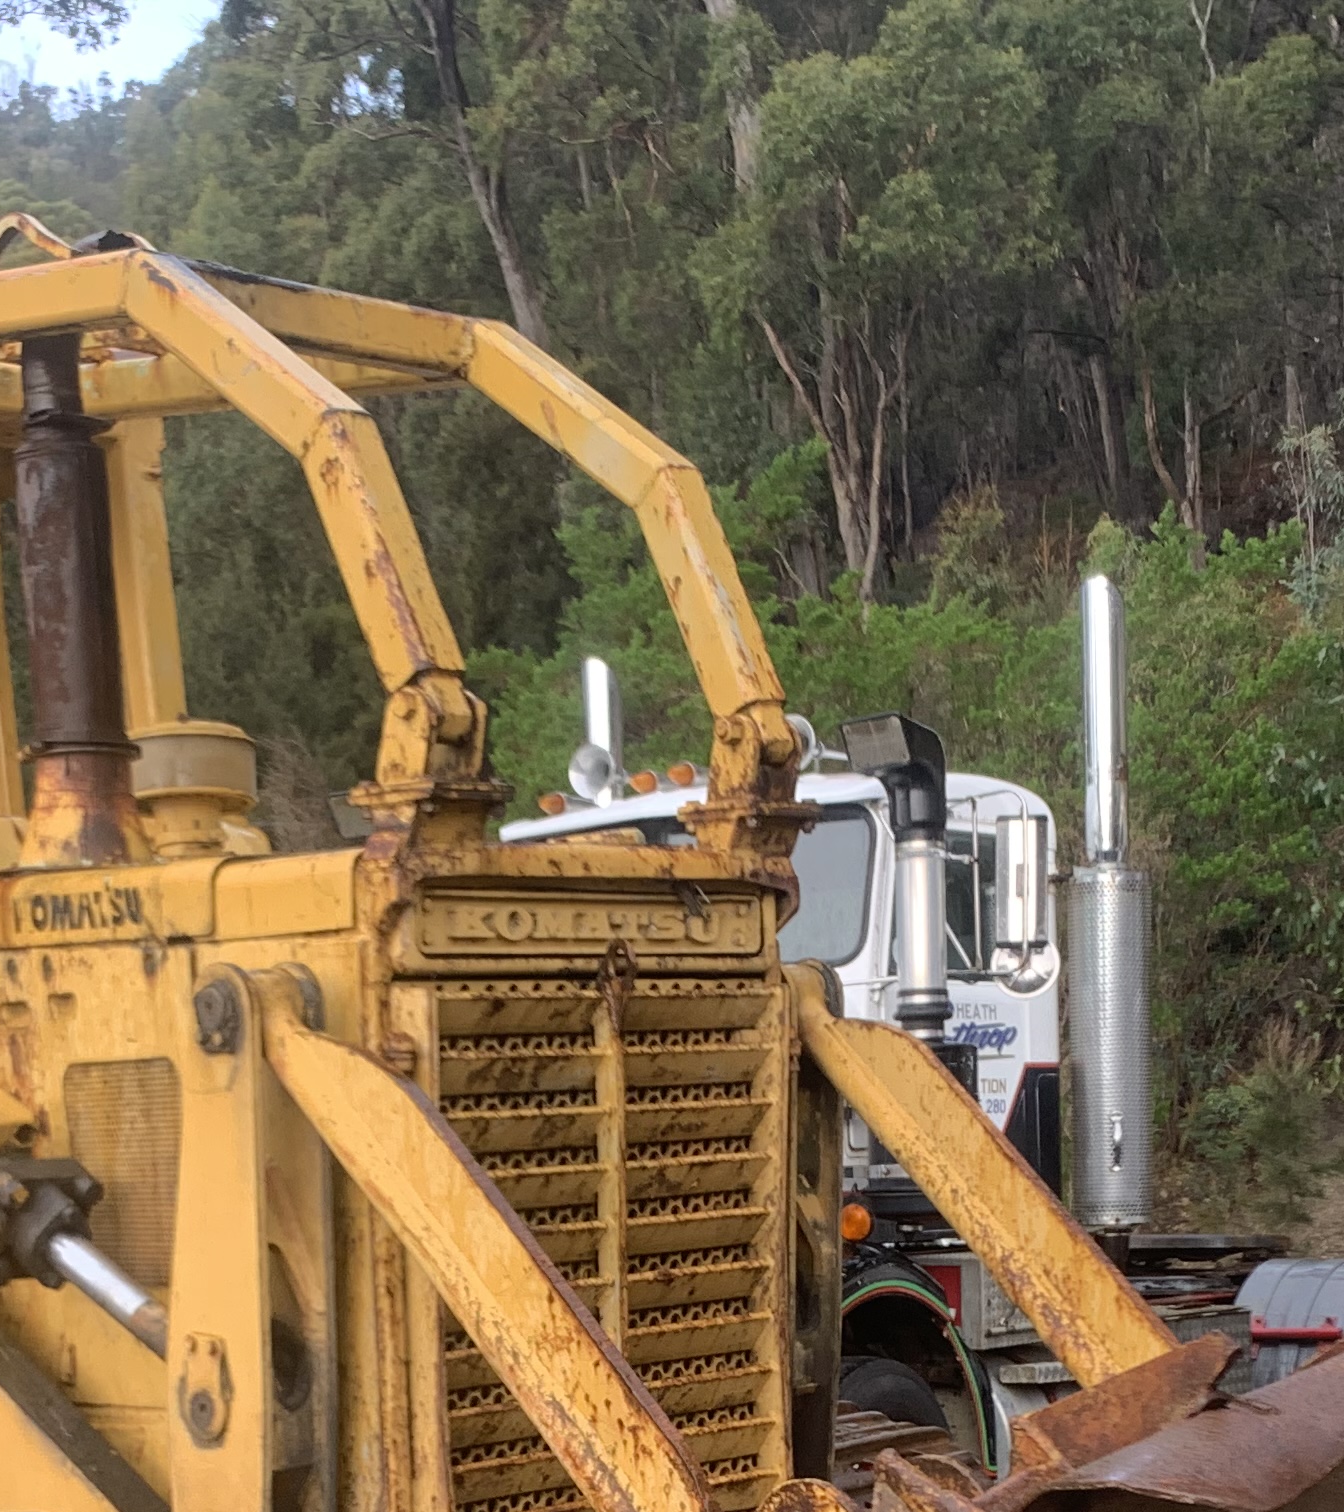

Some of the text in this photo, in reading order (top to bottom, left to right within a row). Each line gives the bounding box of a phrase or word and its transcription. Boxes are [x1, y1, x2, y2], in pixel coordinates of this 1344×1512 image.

[447, 905, 719, 944] KOMATSU
[956, 1003, 998, 1020] HEATH
[980, 1078, 1008, 1094] TION
